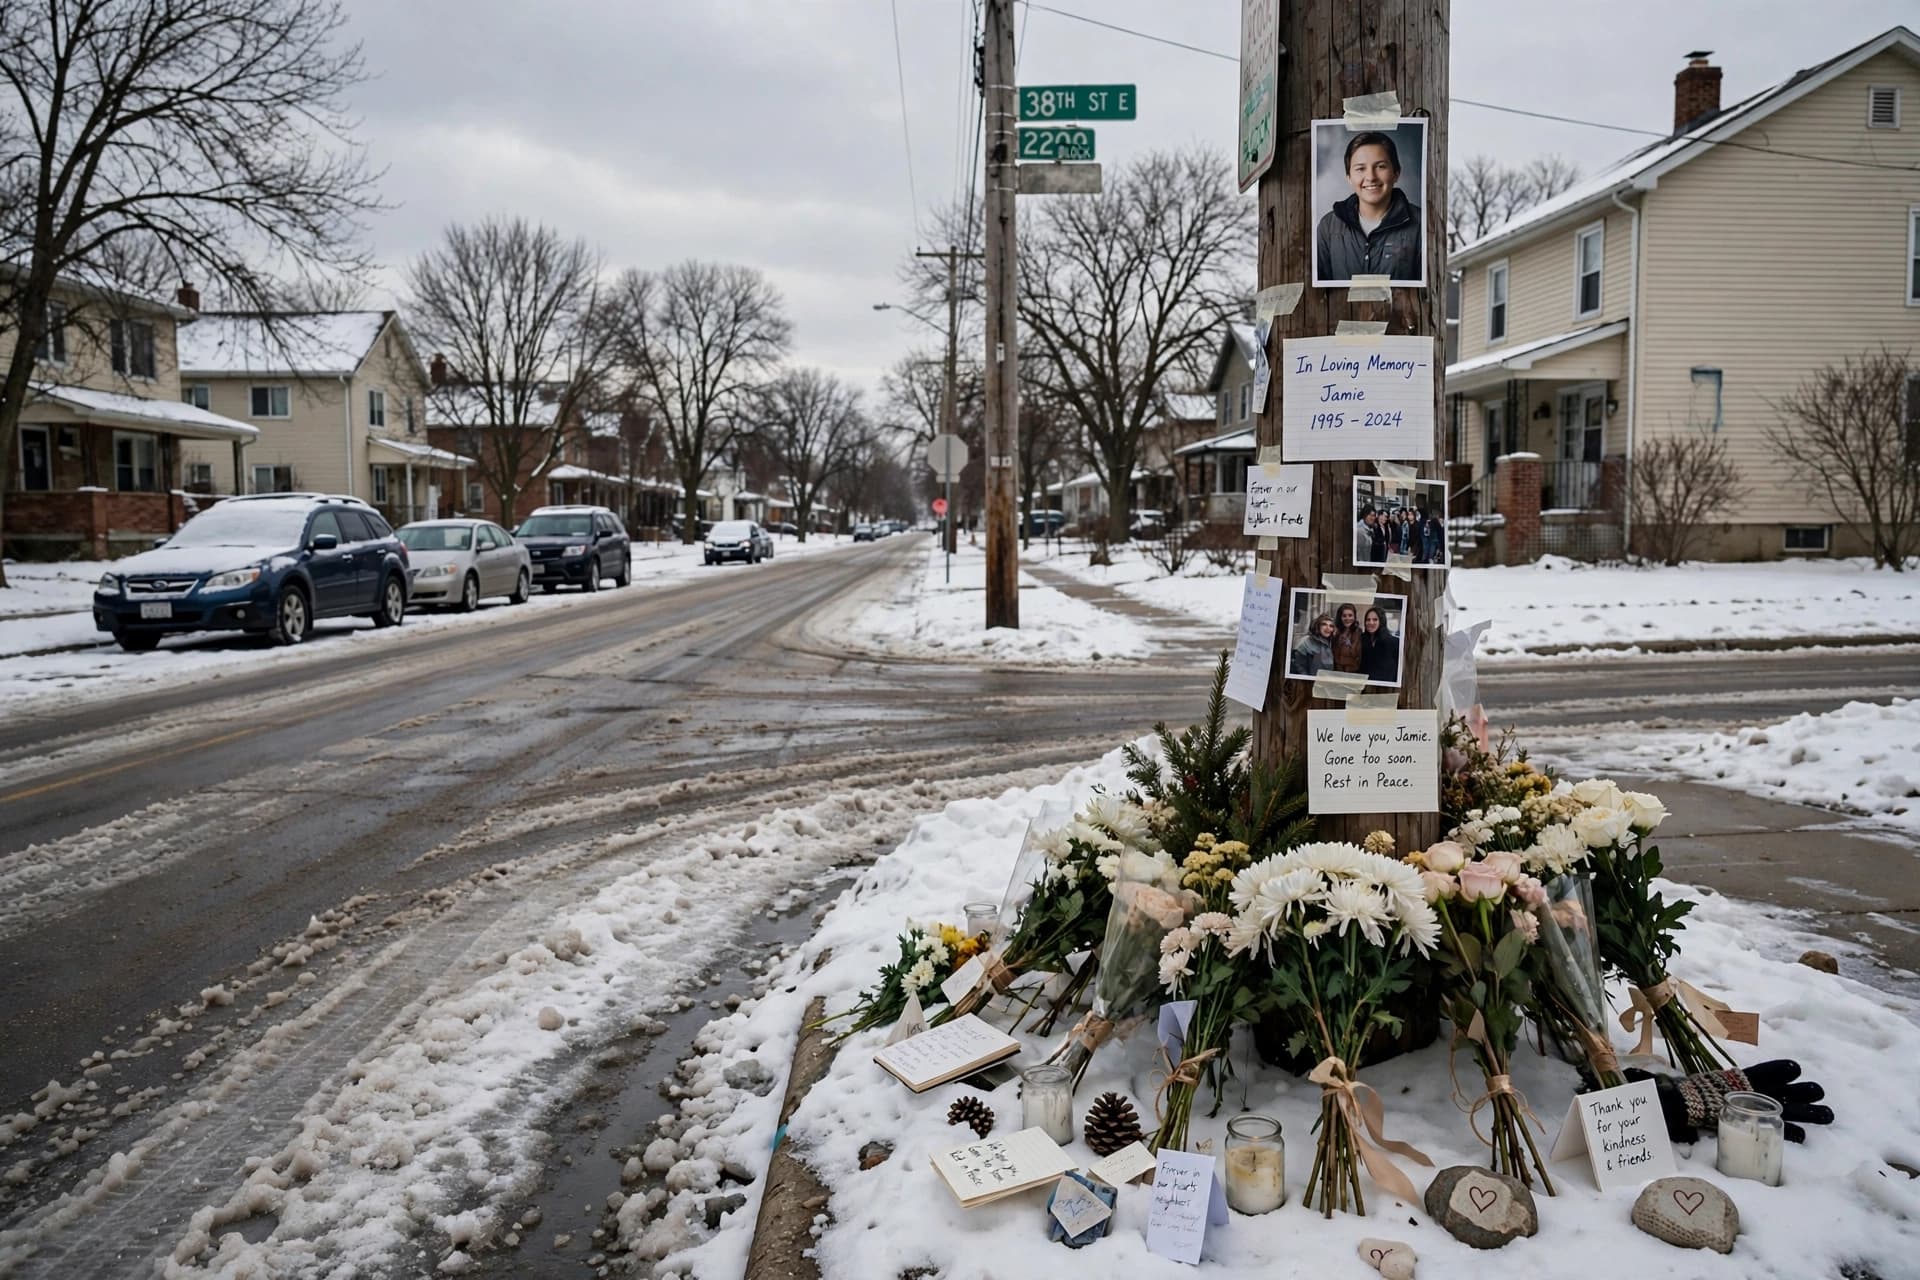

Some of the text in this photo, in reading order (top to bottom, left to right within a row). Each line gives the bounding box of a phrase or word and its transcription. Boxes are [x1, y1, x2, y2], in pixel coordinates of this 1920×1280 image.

[1025, 90, 1129, 117] 38TH ST E
[1295, 355, 1313, 375] In
[1319, 354, 1361, 379] Loving
[1320, 383, 1366, 403] Jamie
[1310, 412, 1346, 431] 1995
[1364, 410, 1403, 428] 2024
[1316, 726, 1432, 748] We love you, Jamie.
[1324, 749, 1417, 766] Gone too soon.
[1324, 772, 1414, 789] Rest in Peace.
[1589, 1097, 1624, 1116] Thank
[1597, 1115, 1641, 1134] for your
[1602, 1133, 1646, 1153] kindness
